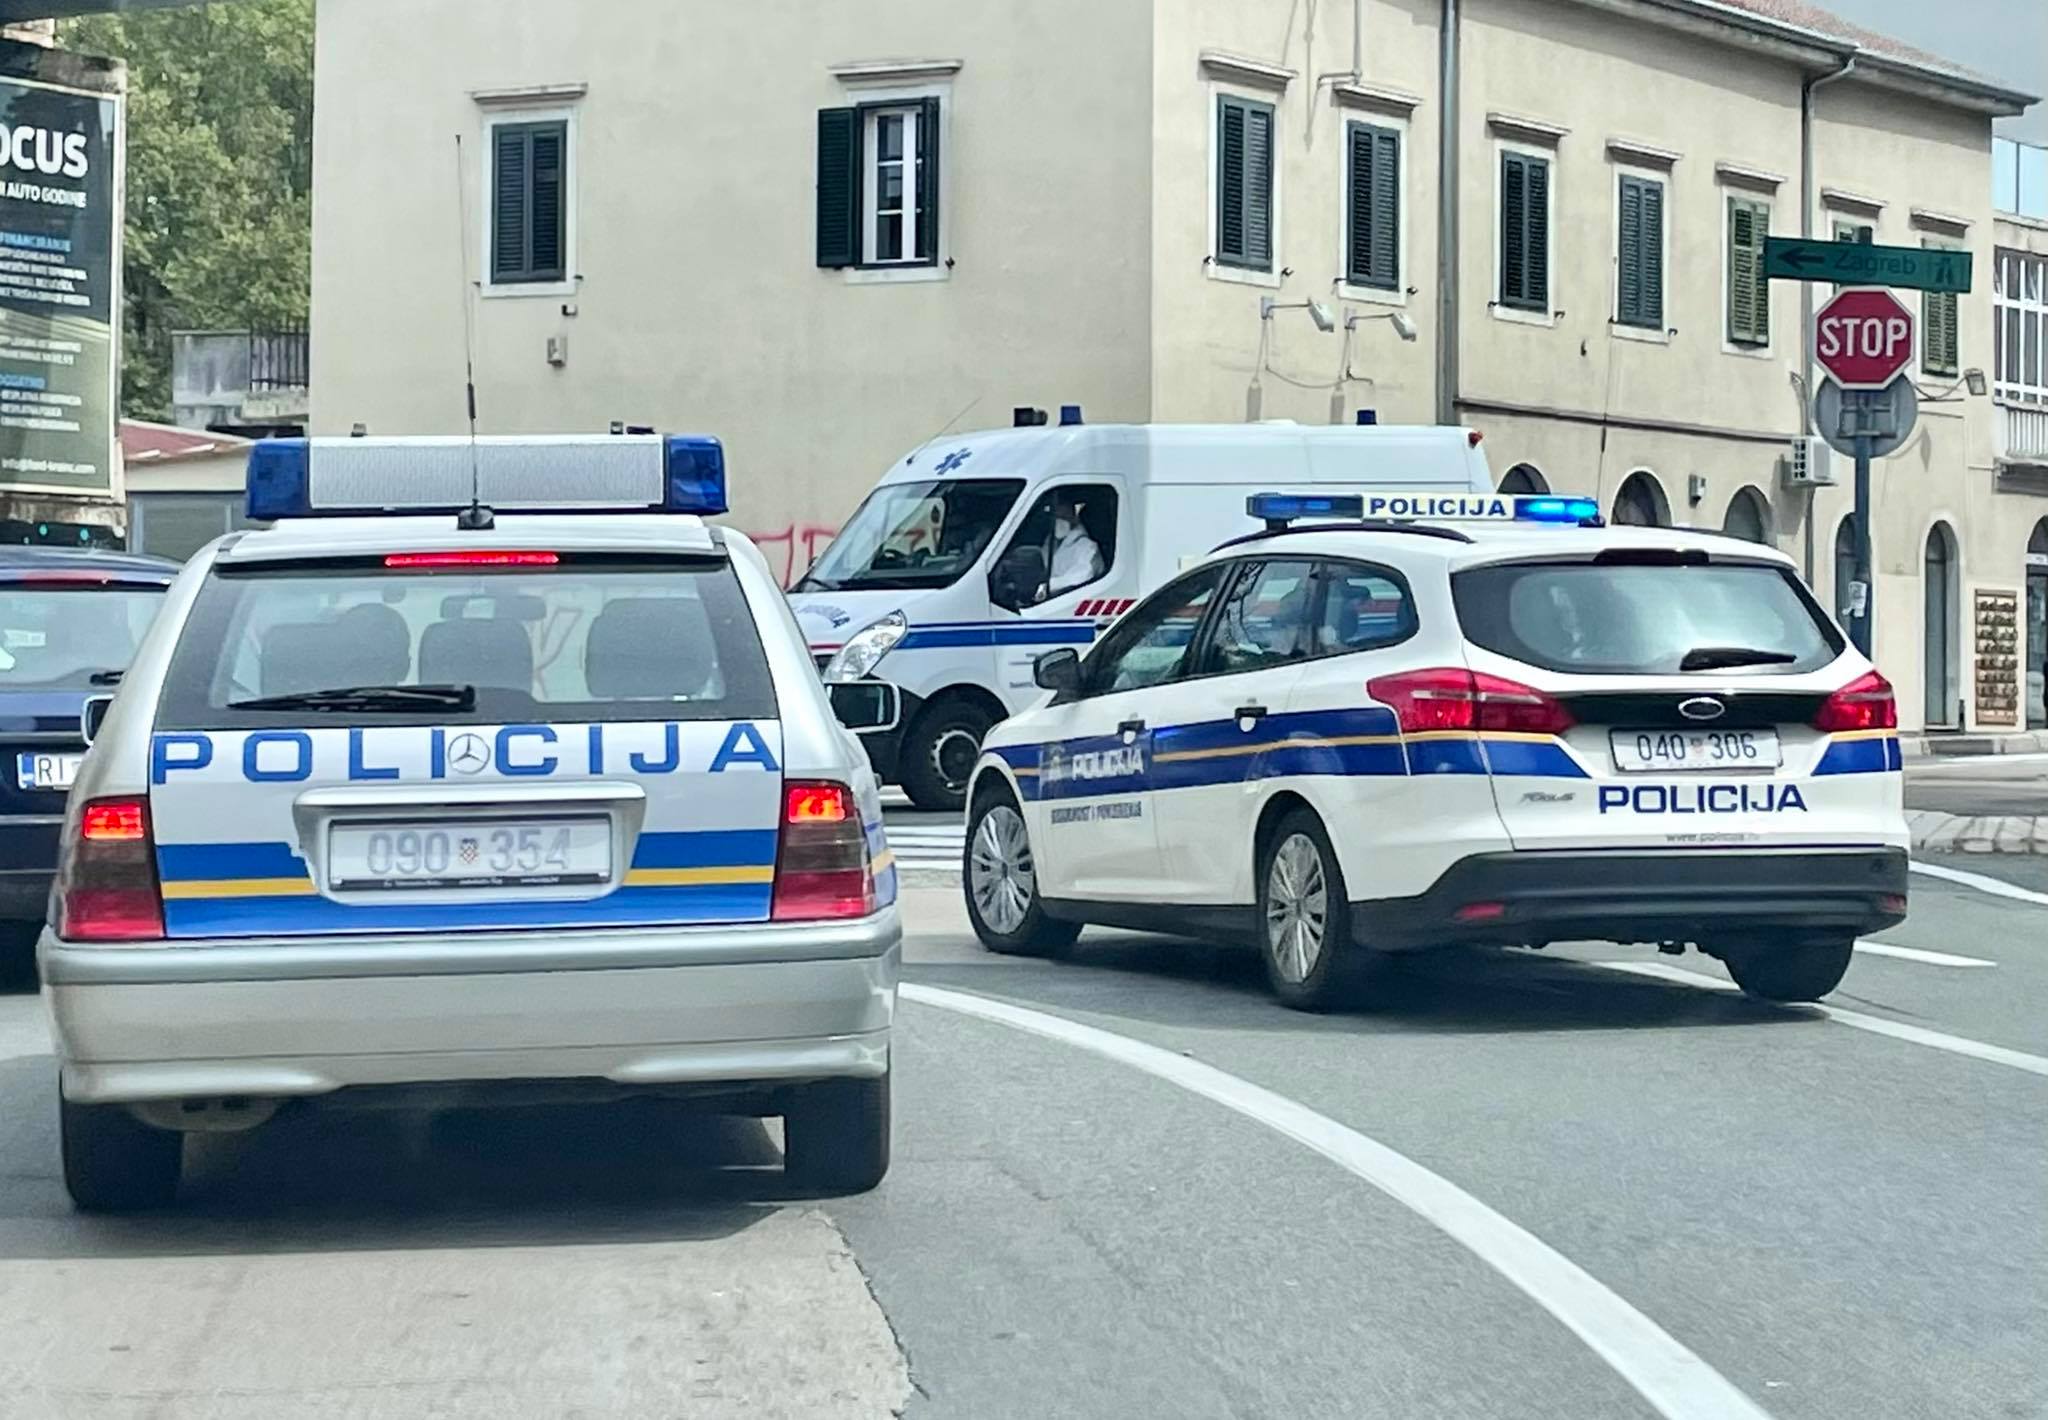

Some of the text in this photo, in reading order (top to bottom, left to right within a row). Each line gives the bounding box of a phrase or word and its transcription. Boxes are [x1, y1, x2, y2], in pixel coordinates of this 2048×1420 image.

[7, 182, 41, 202] AUTO
[1834, 249, 1917, 277] Zagreb
[1819, 316, 1908, 358] STOP
[1369, 497, 1507, 516] POLICIJA
[152, 723, 782, 785] POLICIJA
[1637, 732, 1757, 761] 040 306
[38, 757, 63, 783] RI
[1072, 745, 1144, 781] POLICIJA
[1599, 784, 1808, 814] POLICIJA
[367, 827, 571, 875] 090 354
